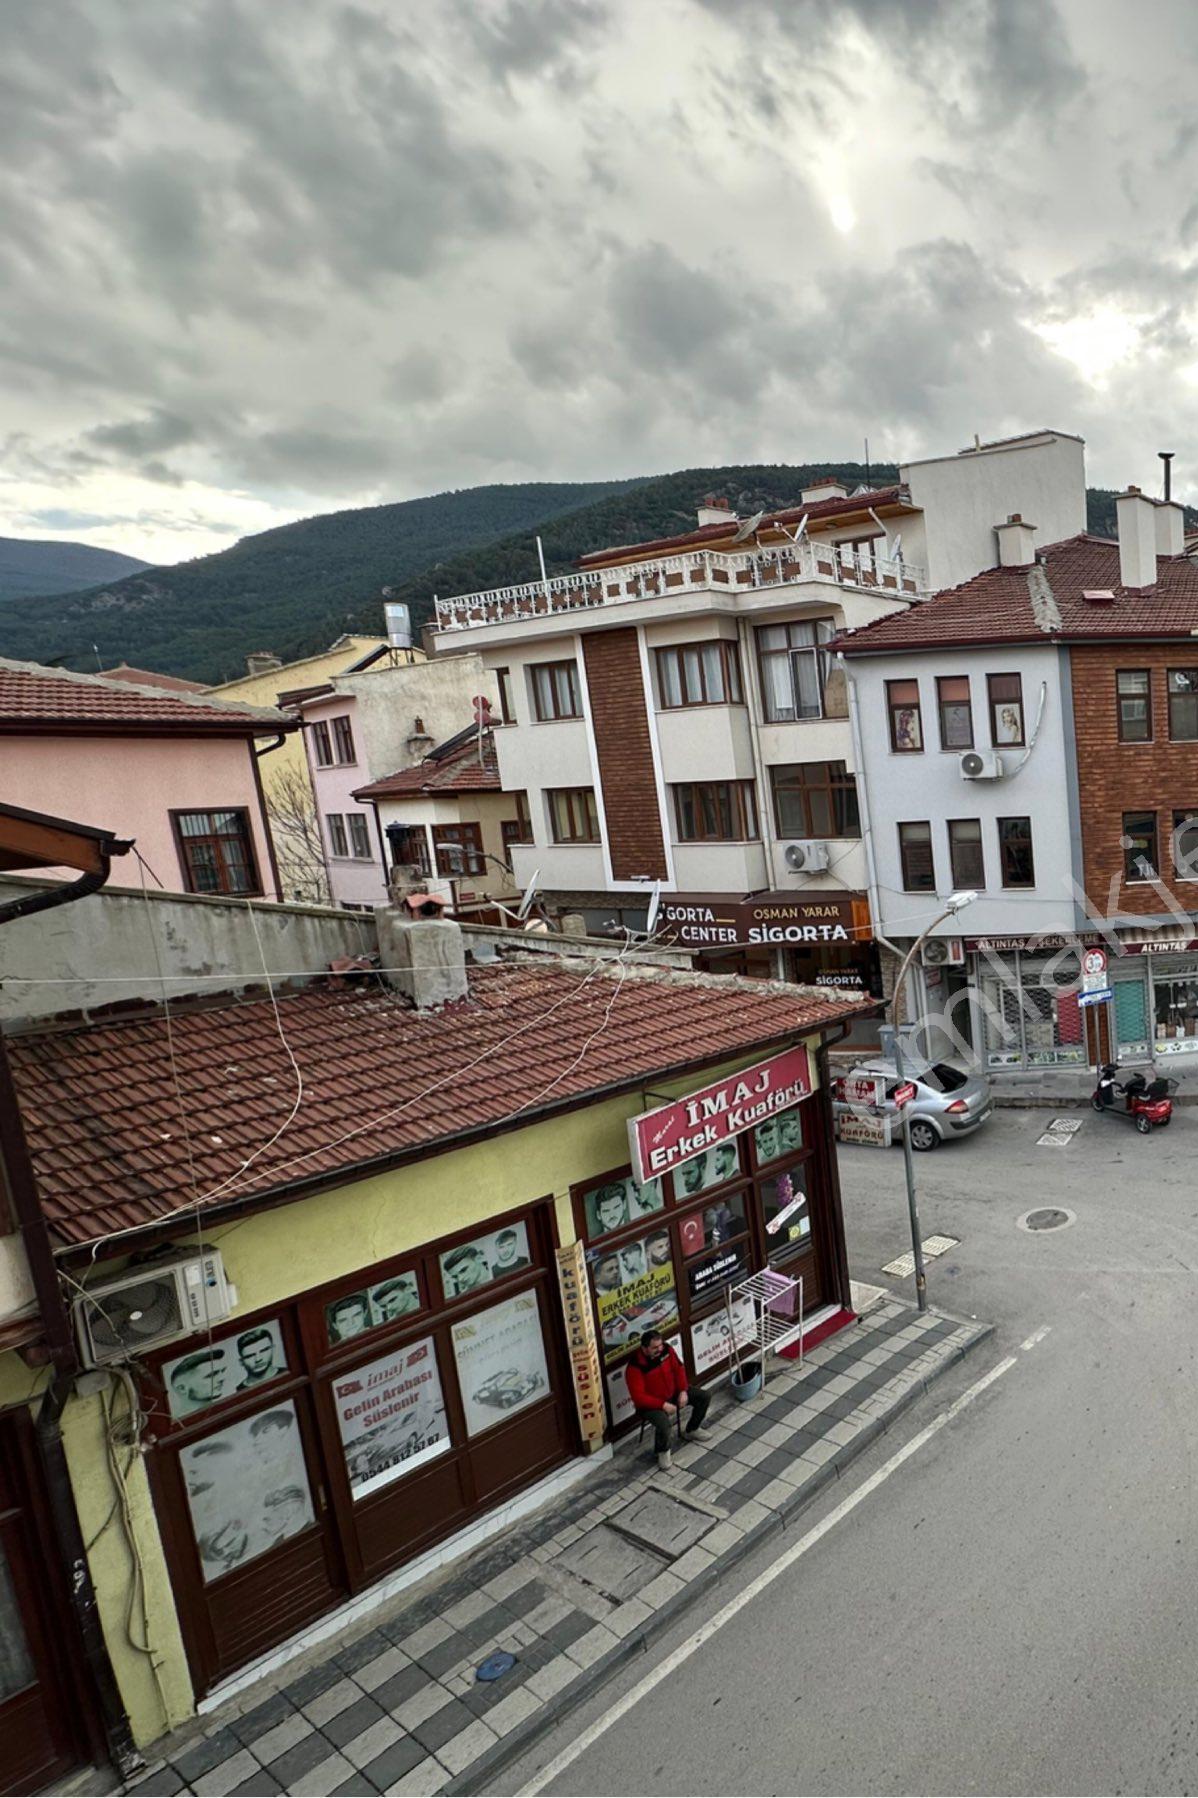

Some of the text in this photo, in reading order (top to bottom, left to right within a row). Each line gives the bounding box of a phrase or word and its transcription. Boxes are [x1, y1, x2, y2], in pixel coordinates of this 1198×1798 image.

[753, 905, 840, 920] OSMAN YARAR
[681, 925, 738, 943] CENTER
[749, 923, 848, 943] SİGORTA
[686, 1069, 771, 1128] İMAJ
[650, 1124, 718, 1171] Erkek
[728, 1078, 807, 1131] Kuaförü
[367, 1359, 403, 1387] imaj
[343, 1370, 433, 1421] Gelin Arabası
[363, 1392, 420, 1427] Süslenir
